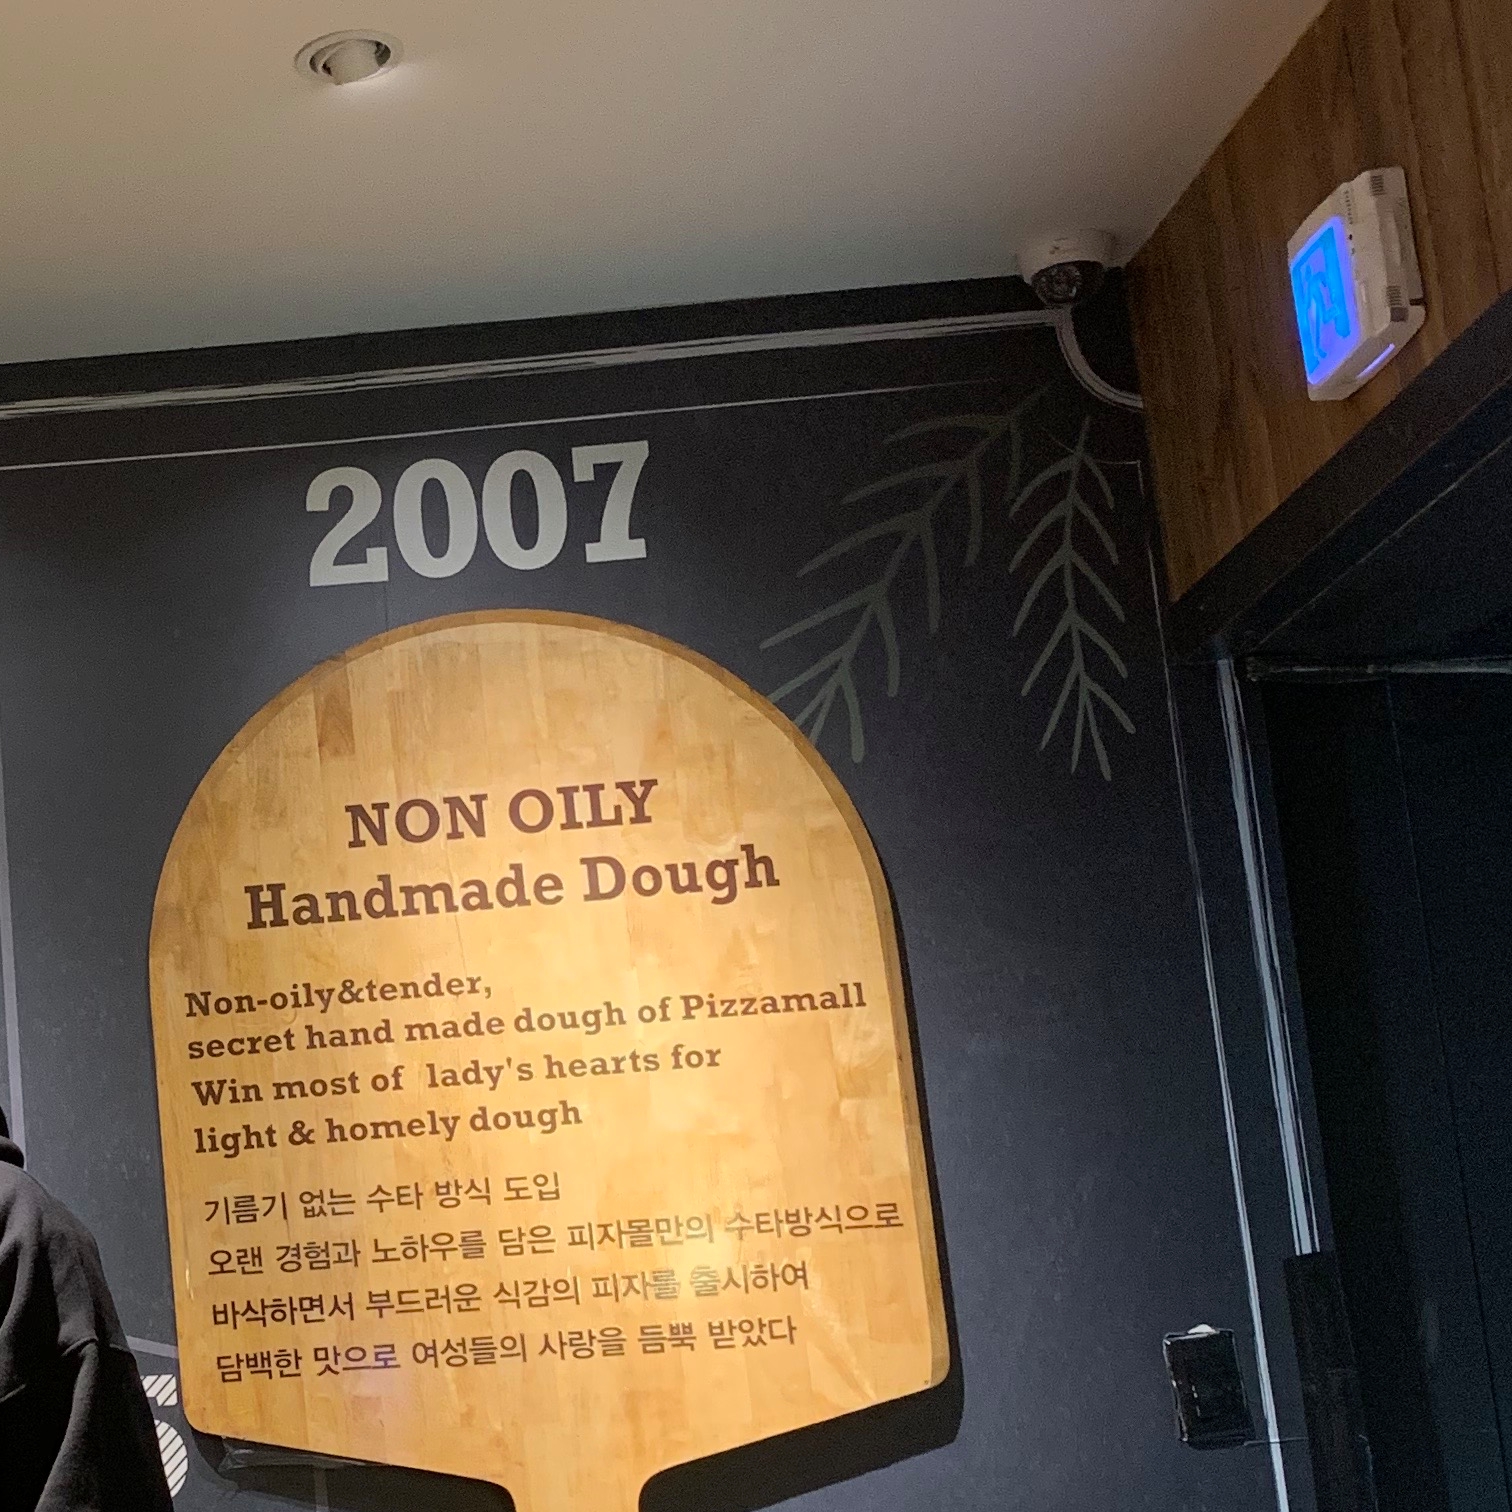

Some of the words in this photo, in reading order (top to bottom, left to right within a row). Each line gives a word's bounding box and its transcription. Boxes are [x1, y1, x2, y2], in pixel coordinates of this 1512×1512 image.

[305, 440, 650, 588] 2007
[344, 793, 489, 849] NON
[508, 778, 659, 834] OILY
[243, 862, 564, 930] Handmade
[579, 843, 781, 906] Dough
[187, 1027, 296, 1060] secret
[304, 1018, 395, 1050] hand
[403, 1011, 505, 1042] made
[513, 1000, 628, 1036] dough
[637, 995, 672, 1024] of
[679, 981, 867, 1021] Pizzamall
[190, 1078, 264, 1107] Win
[271, 1071, 361, 1101] most
[370, 1064, 406, 1092] of
[425, 1056, 534, 1092] lady's
[542, 1049, 661, 1080] hearts
[670, 1043, 722, 1070] for
[193, 1123, 278, 1159] light
[288, 1119, 316, 1146] &
[324, 1110, 461, 1144] homely
[469, 1099, 583, 1135] dough
[204, 1191, 288, 1226] 기름기
[298, 1188, 357, 1219] 없는
[366, 1181, 424, 1214] 수타
[434, 1176, 492, 1209] 방식
[503, 1171, 561, 1202] 도입
[208, 1245, 264, 1276] 오랜
[275, 1238, 362, 1273] 경험과
[371, 1229, 487, 1264] 노하우를
[498, 1224, 557, 1257] 담은
[566, 1213, 714, 1251] 피자몰만의
[725, 1202, 905, 1241] 수타방식으로
[212, 1291, 355, 1330] 바삭하면서
[365, 1283, 483, 1319] 부드러운
[492, 1275, 581, 1310] 식감의
[590, 1269, 681, 1304] 피자를
[689, 1259, 809, 1298] 출시하여
[216, 1348, 303, 1384] 담백한
[313, 1343, 401, 1377] 맛으로
[412, 1332, 527, 1369] 여성들의
[538, 1326, 627, 1361] 사랑을
[637, 1322, 697, 1355] 듬뿍
[707, 1315, 798, 1350] 받았다
